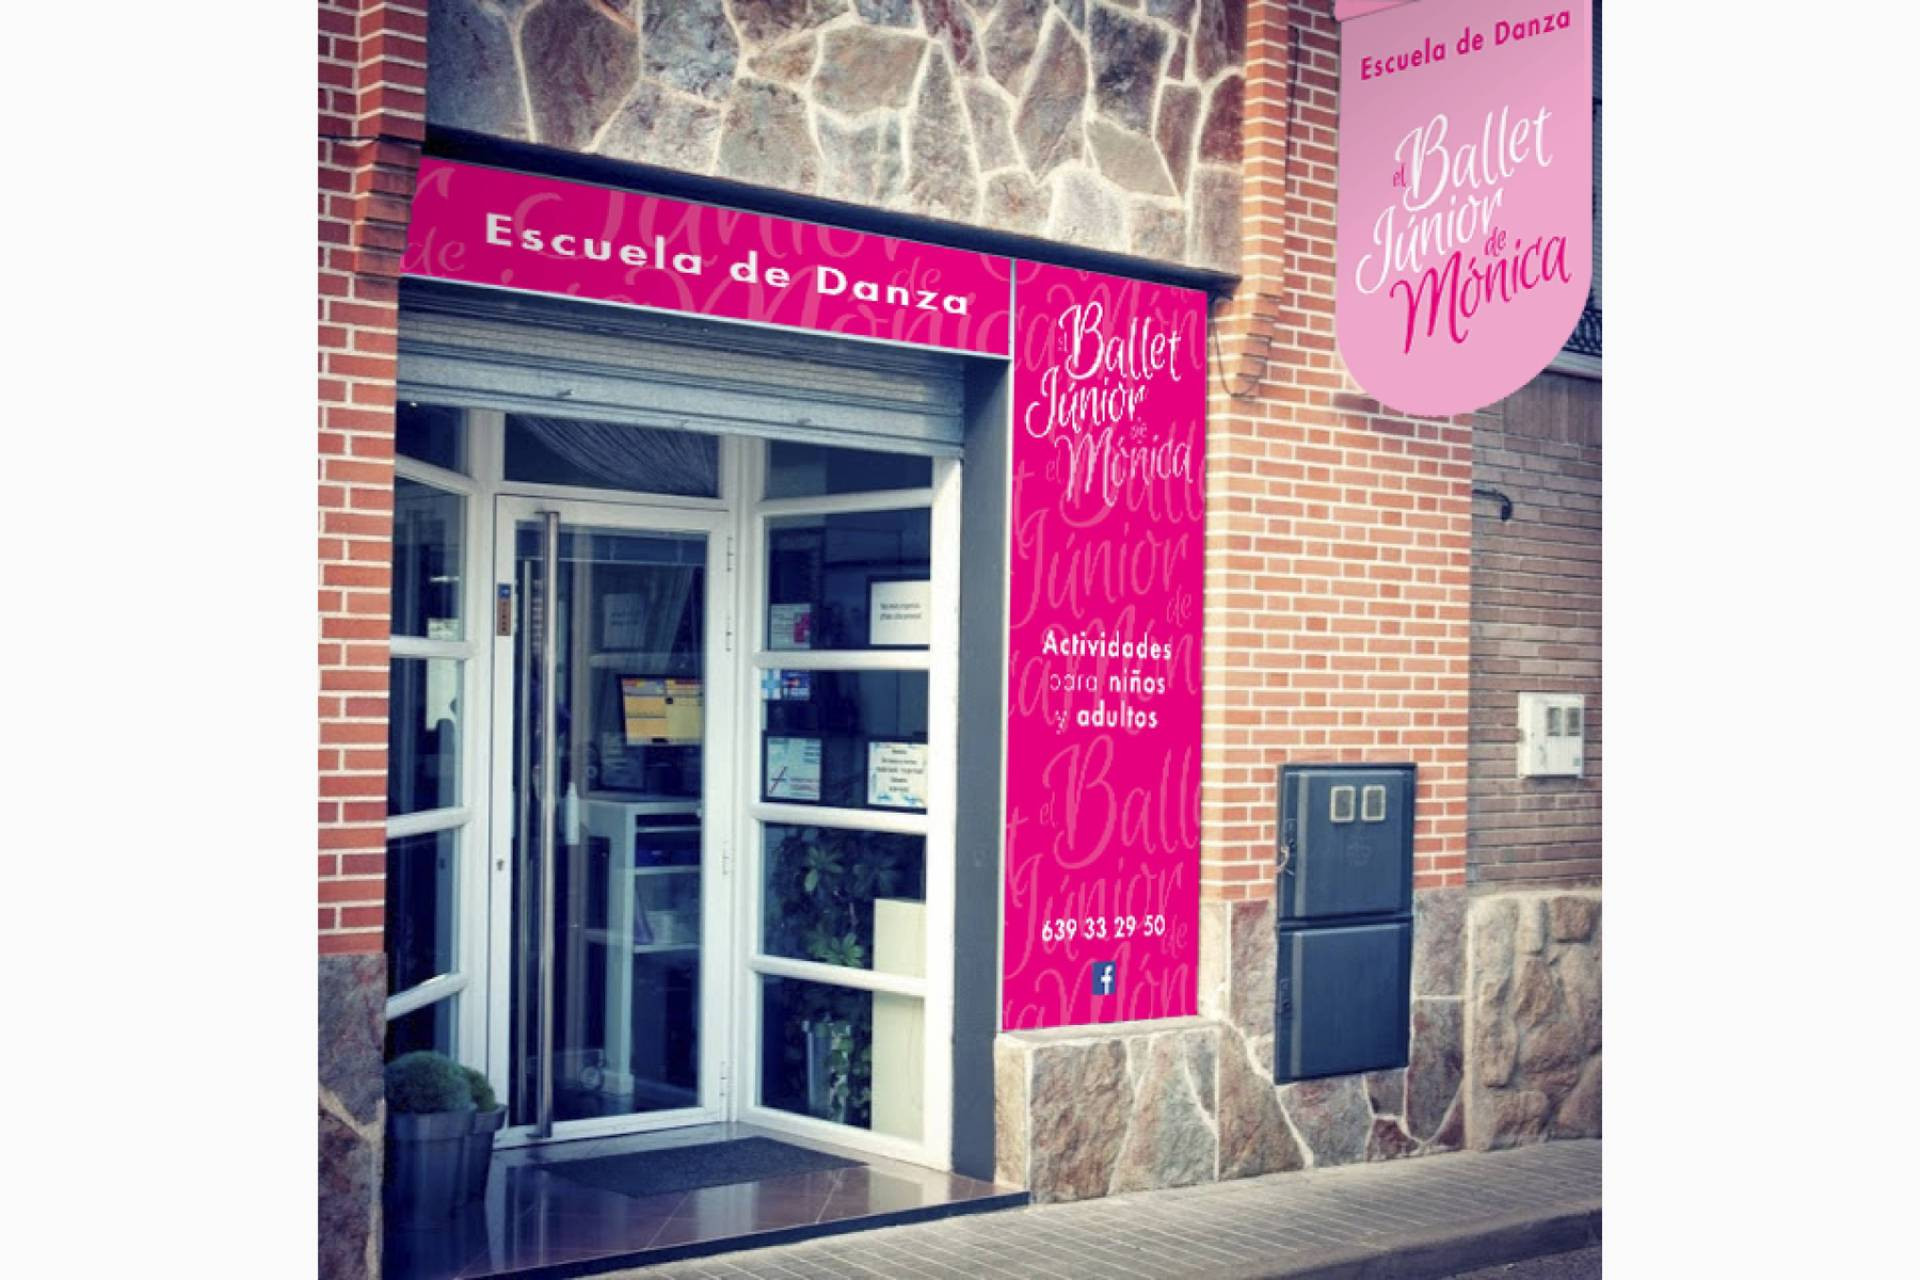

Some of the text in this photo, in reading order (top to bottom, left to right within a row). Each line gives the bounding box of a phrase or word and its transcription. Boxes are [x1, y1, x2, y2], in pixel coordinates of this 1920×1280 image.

[1360, 10, 1571, 80] Escuela de Danza
[1393, 105, 1553, 212] el Ballet
[486, 212, 967, 315] Escuela de Danza
[1355, 187, 1504, 294] Júnior
[1484, 226, 1506, 257] de
[1058, 301, 1182, 382] Ballet
[1025, 365, 1146, 438] Júnior
[1042, 630, 1171, 660] Actividades
[1076, 699, 1158, 728] adultos
[1109, 667, 1166, 694] niños
[1042, 914, 1166, 942] 639 33 29 50
